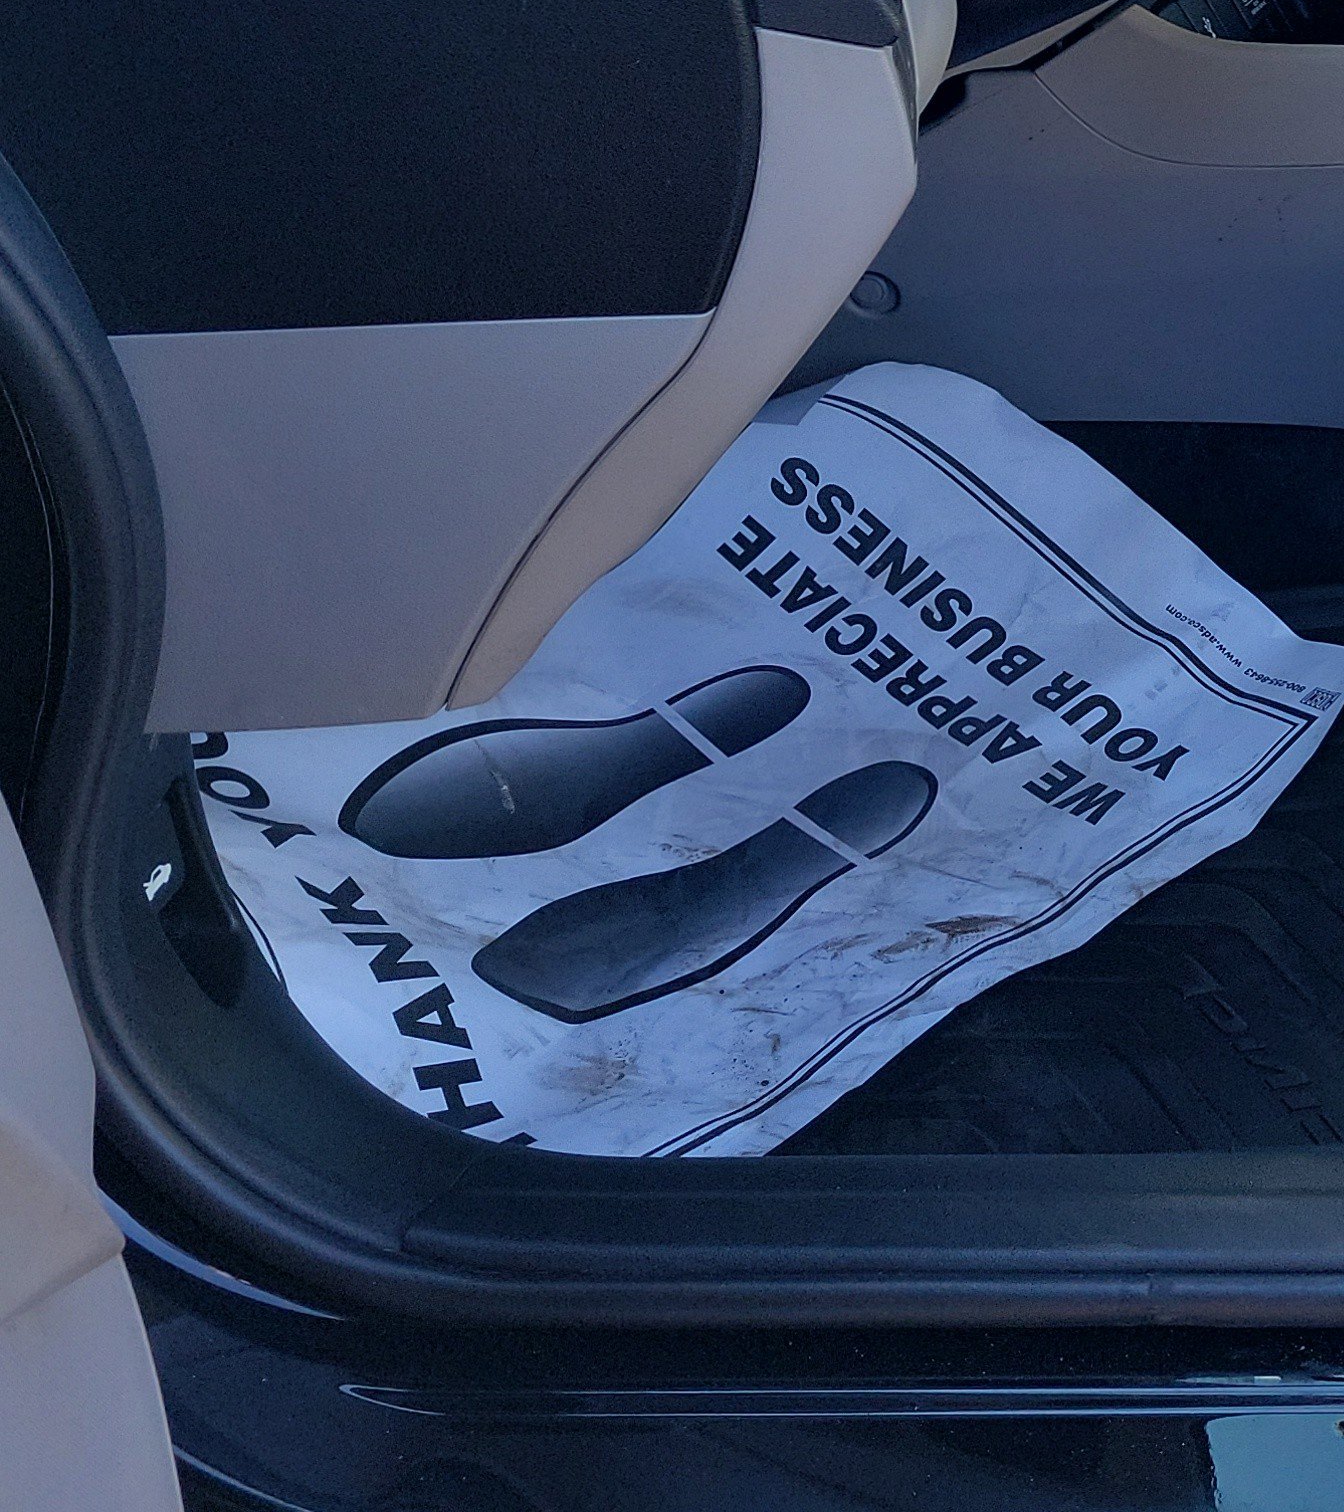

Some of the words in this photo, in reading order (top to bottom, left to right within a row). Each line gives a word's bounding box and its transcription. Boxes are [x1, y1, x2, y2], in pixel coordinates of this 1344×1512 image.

[716, 515, 1042, 764] APPRECIATE
[770, 456, 1045, 686] BUSINESS
[1022, 760, 1125, 825] WE
[1032, 671, 1190, 781] YOUR
[294, 875, 538, 1147] HANK
